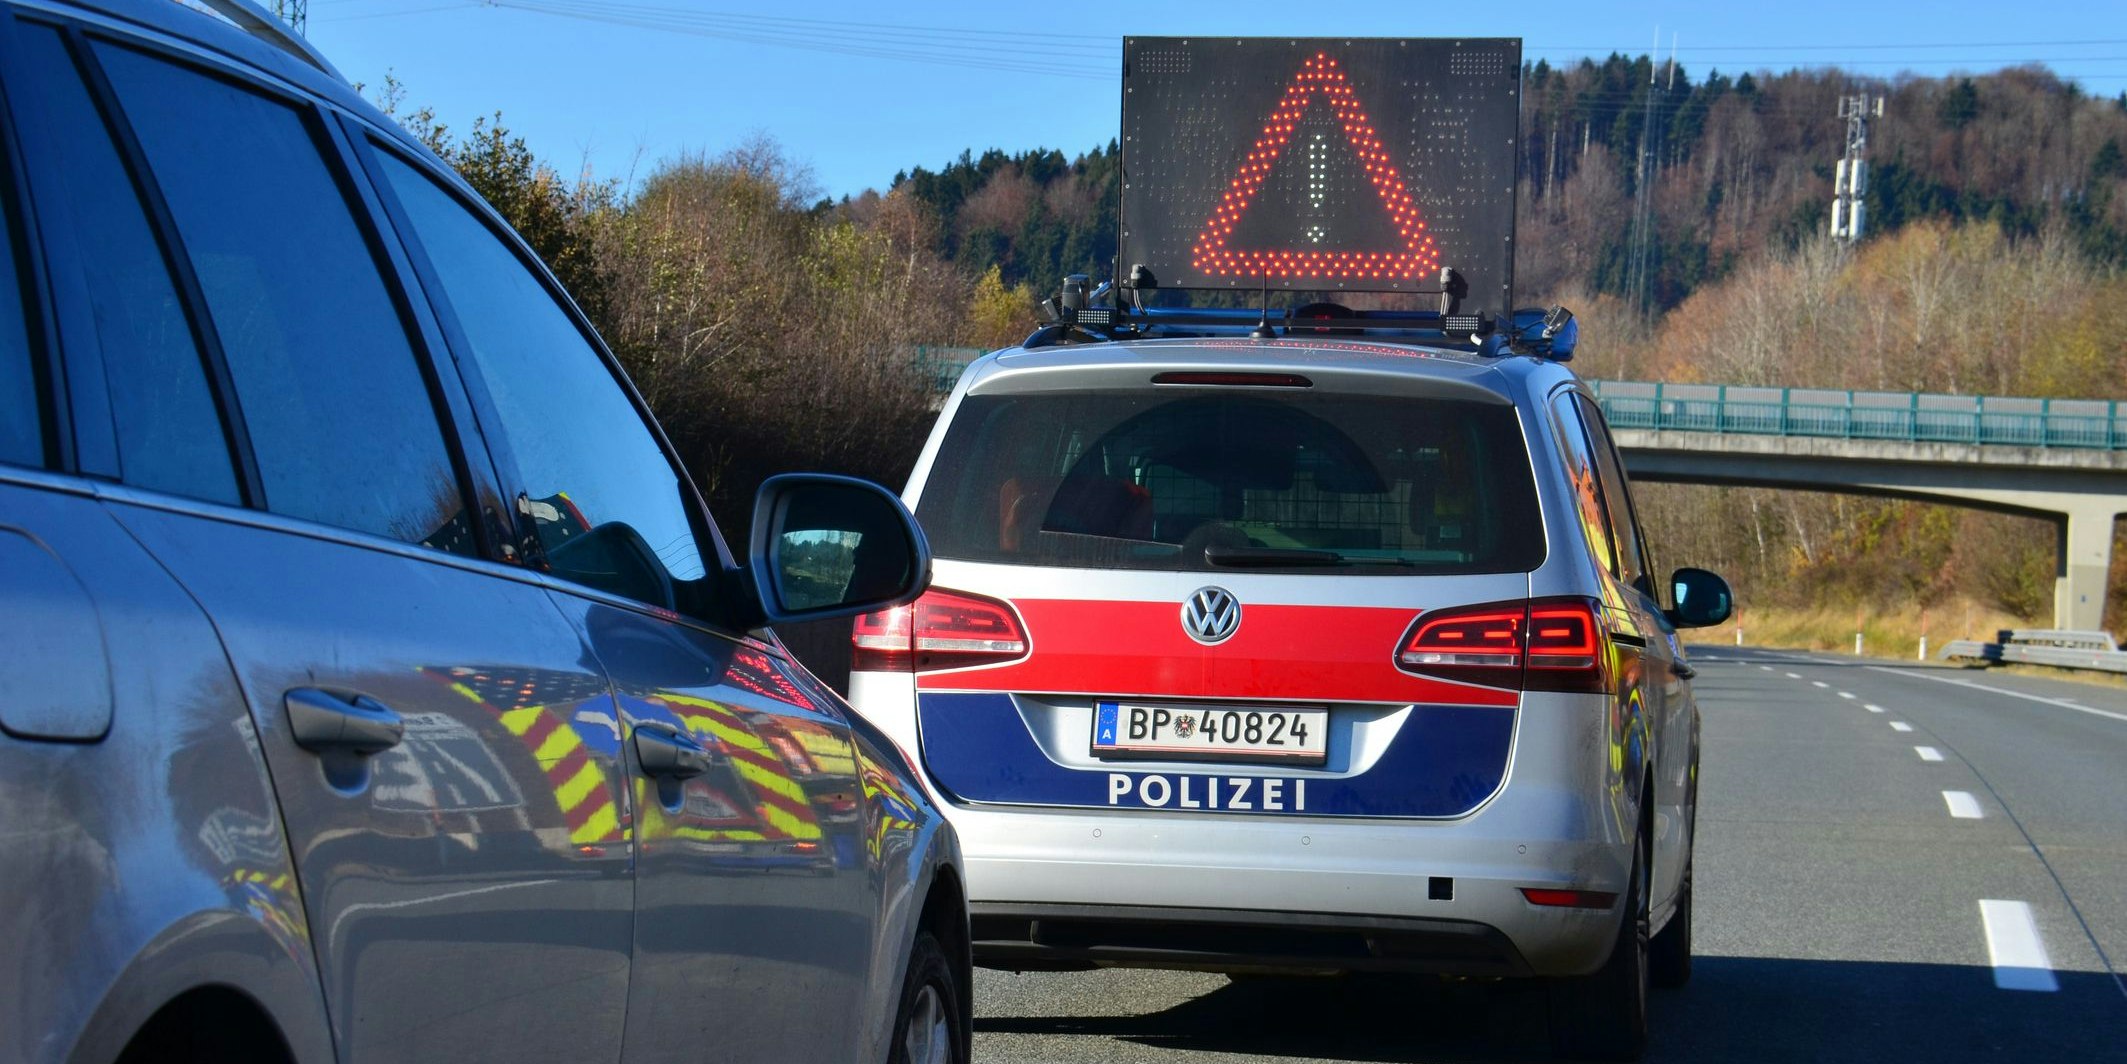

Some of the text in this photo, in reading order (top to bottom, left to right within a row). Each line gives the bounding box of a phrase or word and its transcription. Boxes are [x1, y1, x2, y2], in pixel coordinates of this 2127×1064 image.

[1184, 587, 1238, 642] VW
[1102, 729, 1112, 739] A
[1129, 708, 1308, 746] BP 40824
[1109, 774, 1305, 810] POLIZEI
